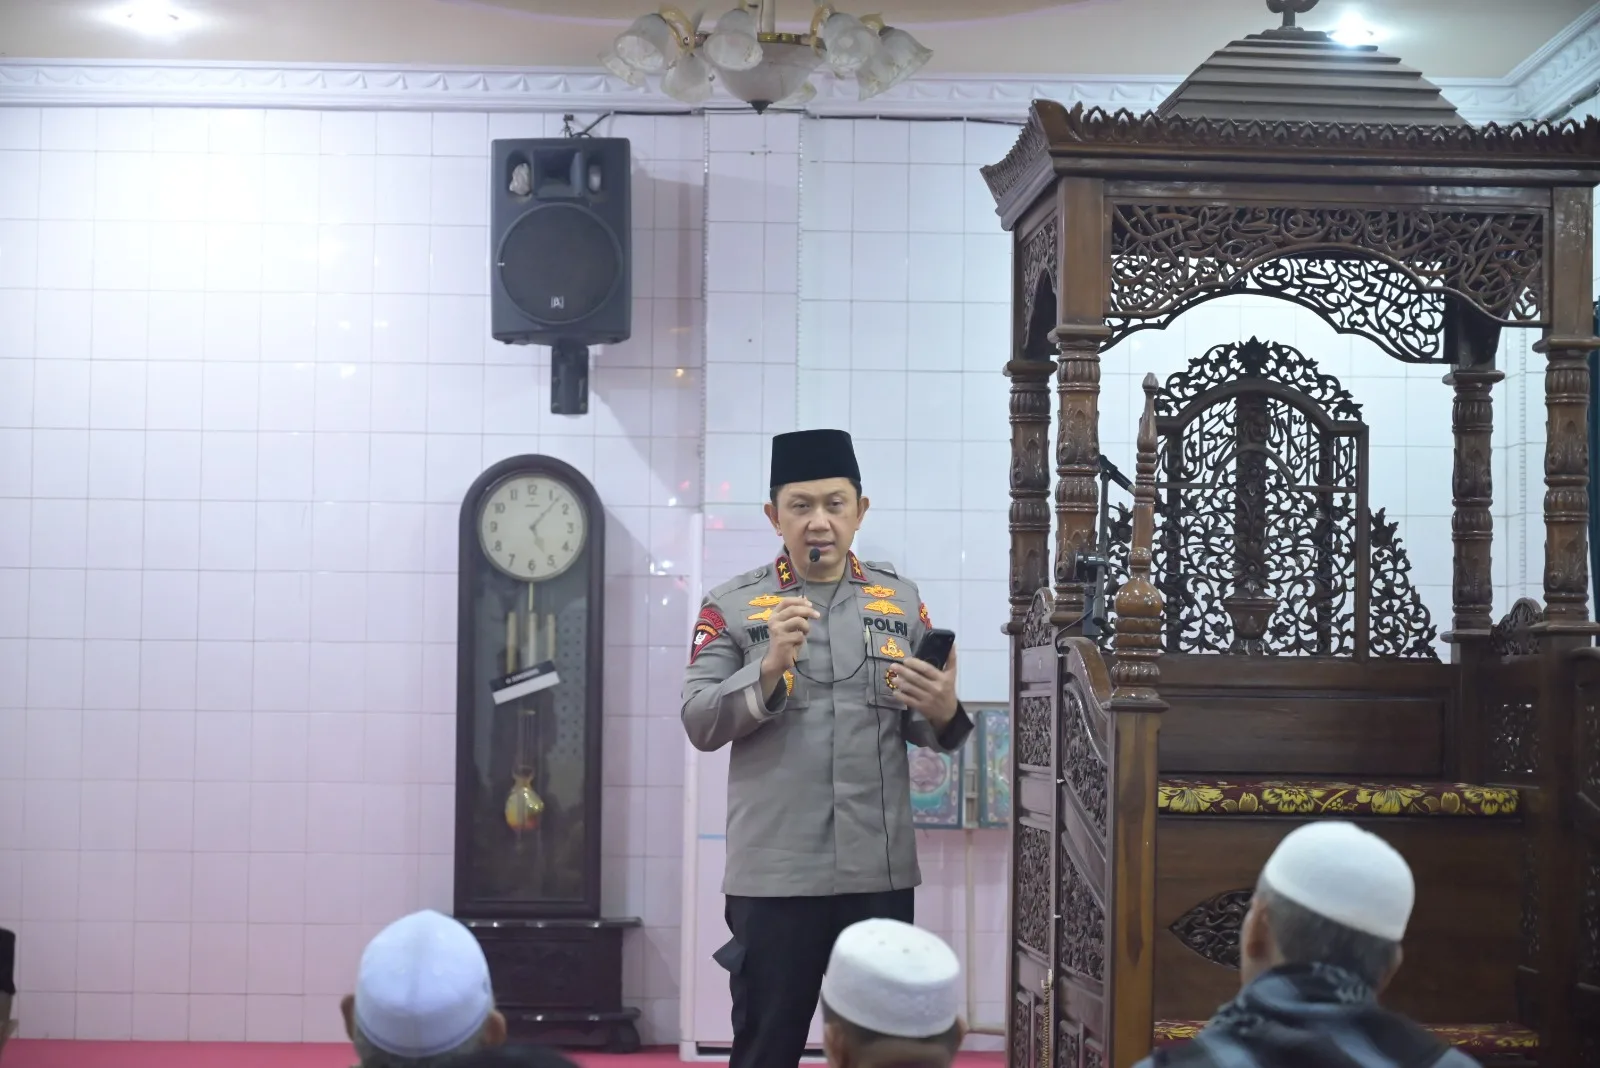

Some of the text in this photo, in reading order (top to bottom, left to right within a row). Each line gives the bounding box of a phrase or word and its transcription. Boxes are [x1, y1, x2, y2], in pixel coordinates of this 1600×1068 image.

[510, 489, 518, 501] 11
[527, 484, 538, 496] 12
[495, 502, 506, 514] 10
[562, 503, 570, 515] 2
[490, 521, 498, 533] 9
[566, 522, 574, 534] 3
[495, 540, 502, 552] 8
[562, 540, 570, 552] 4
[509, 553, 516, 568] 7
[527, 559, 536, 571] 6
[547, 555, 555, 567] 5
[863, 616, 908, 637] POLRI
